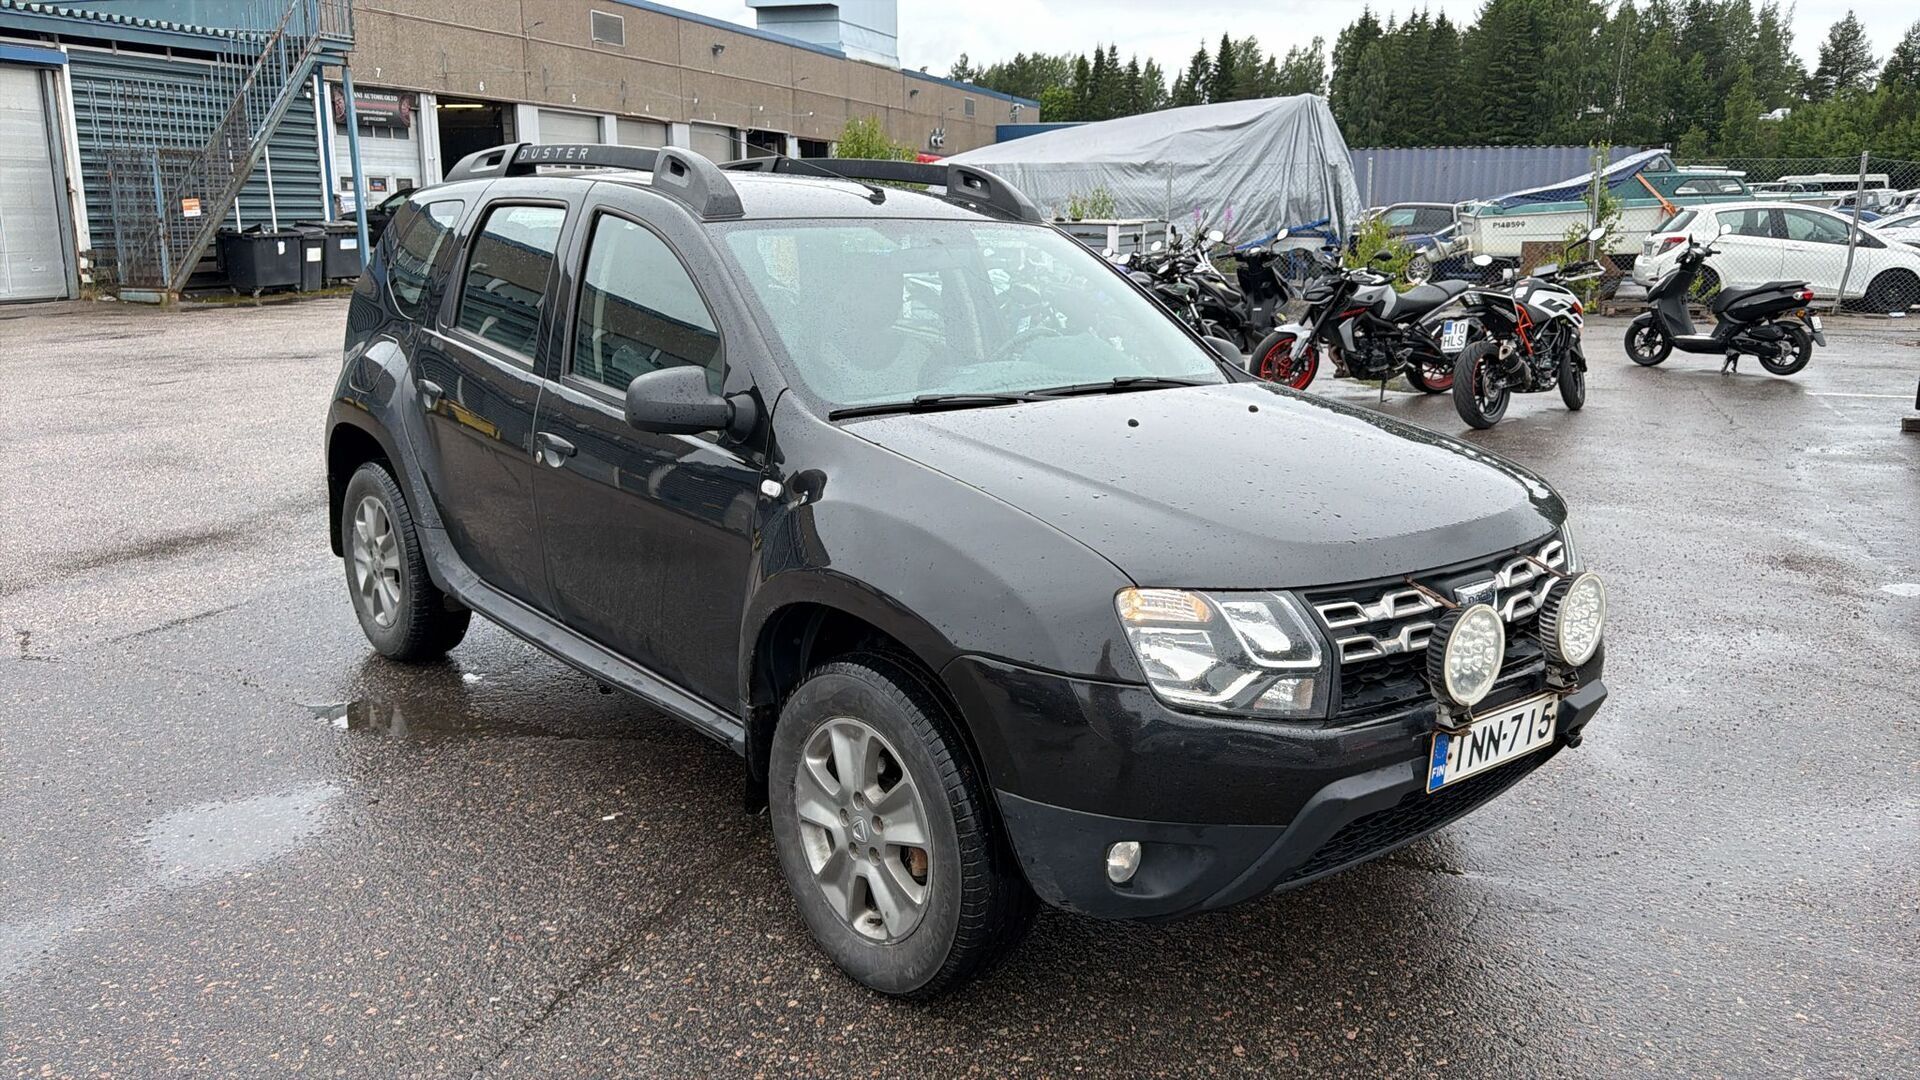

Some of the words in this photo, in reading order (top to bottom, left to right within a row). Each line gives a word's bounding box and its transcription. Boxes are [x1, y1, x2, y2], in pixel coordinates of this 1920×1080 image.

[375, 67, 382, 78] 7
[518, 146, 589, 161] DUSTER
[1454, 322, 1466, 336] 10
[1443, 335, 1464, 347] HLS
[1431, 764, 1446, 780] FIN
